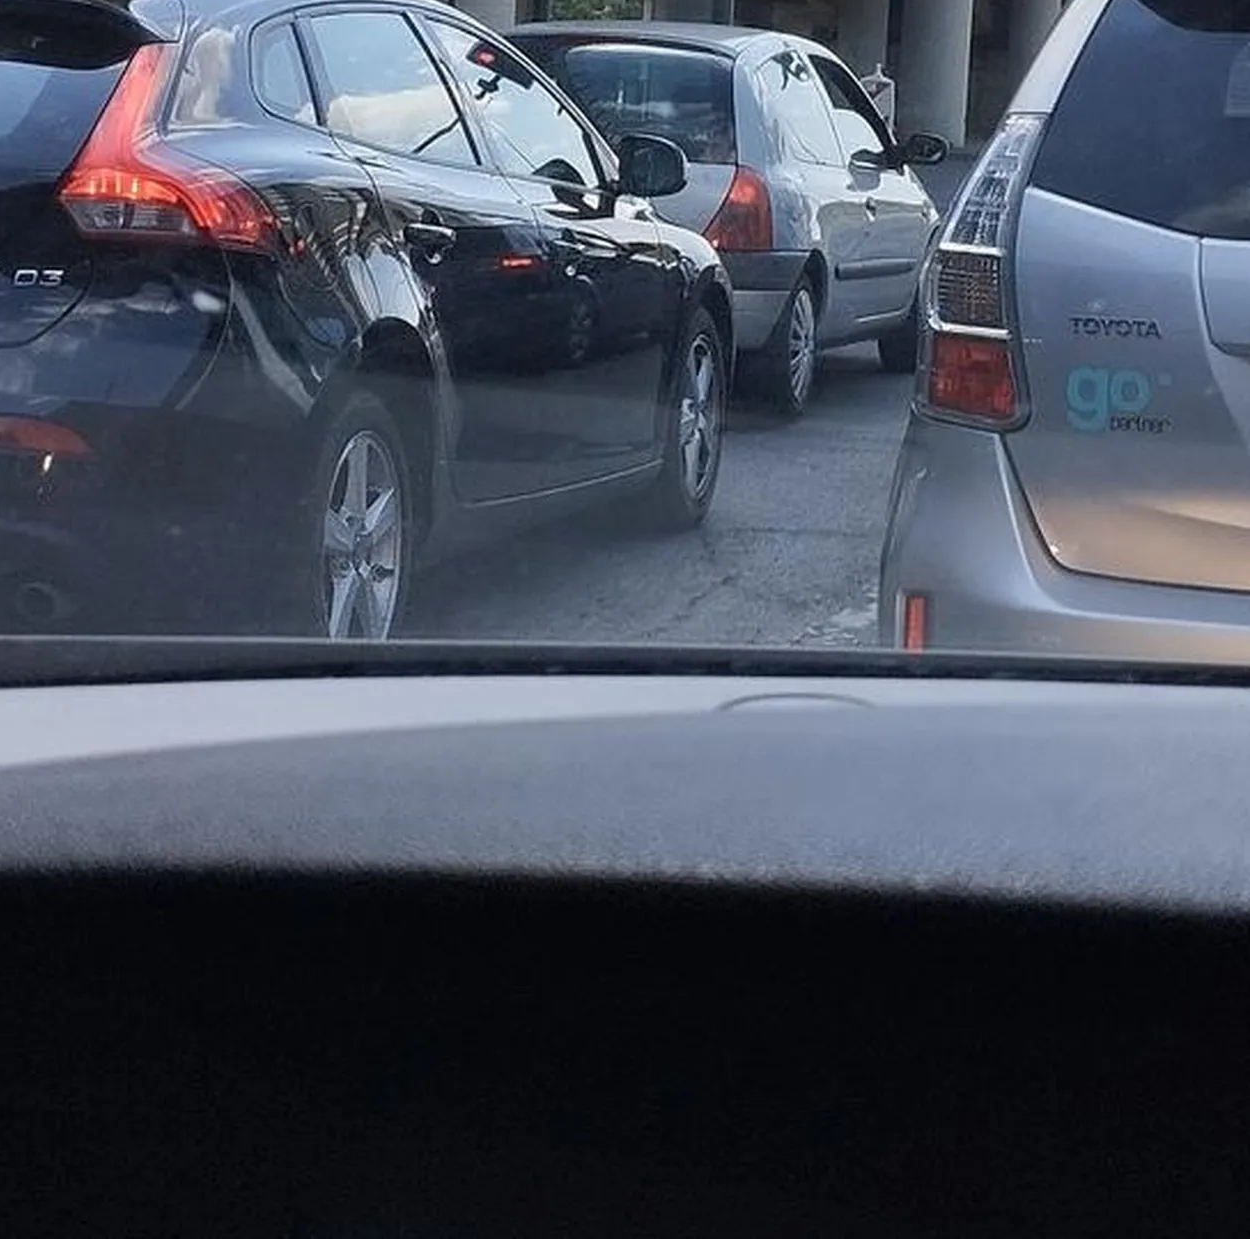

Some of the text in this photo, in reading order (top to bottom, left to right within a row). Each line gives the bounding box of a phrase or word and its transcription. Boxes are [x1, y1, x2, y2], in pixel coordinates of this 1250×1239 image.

[14, 269, 64, 285] D3
[1069, 317, 1162, 339] TOYOTA
[1067, 366, 1152, 432] go
